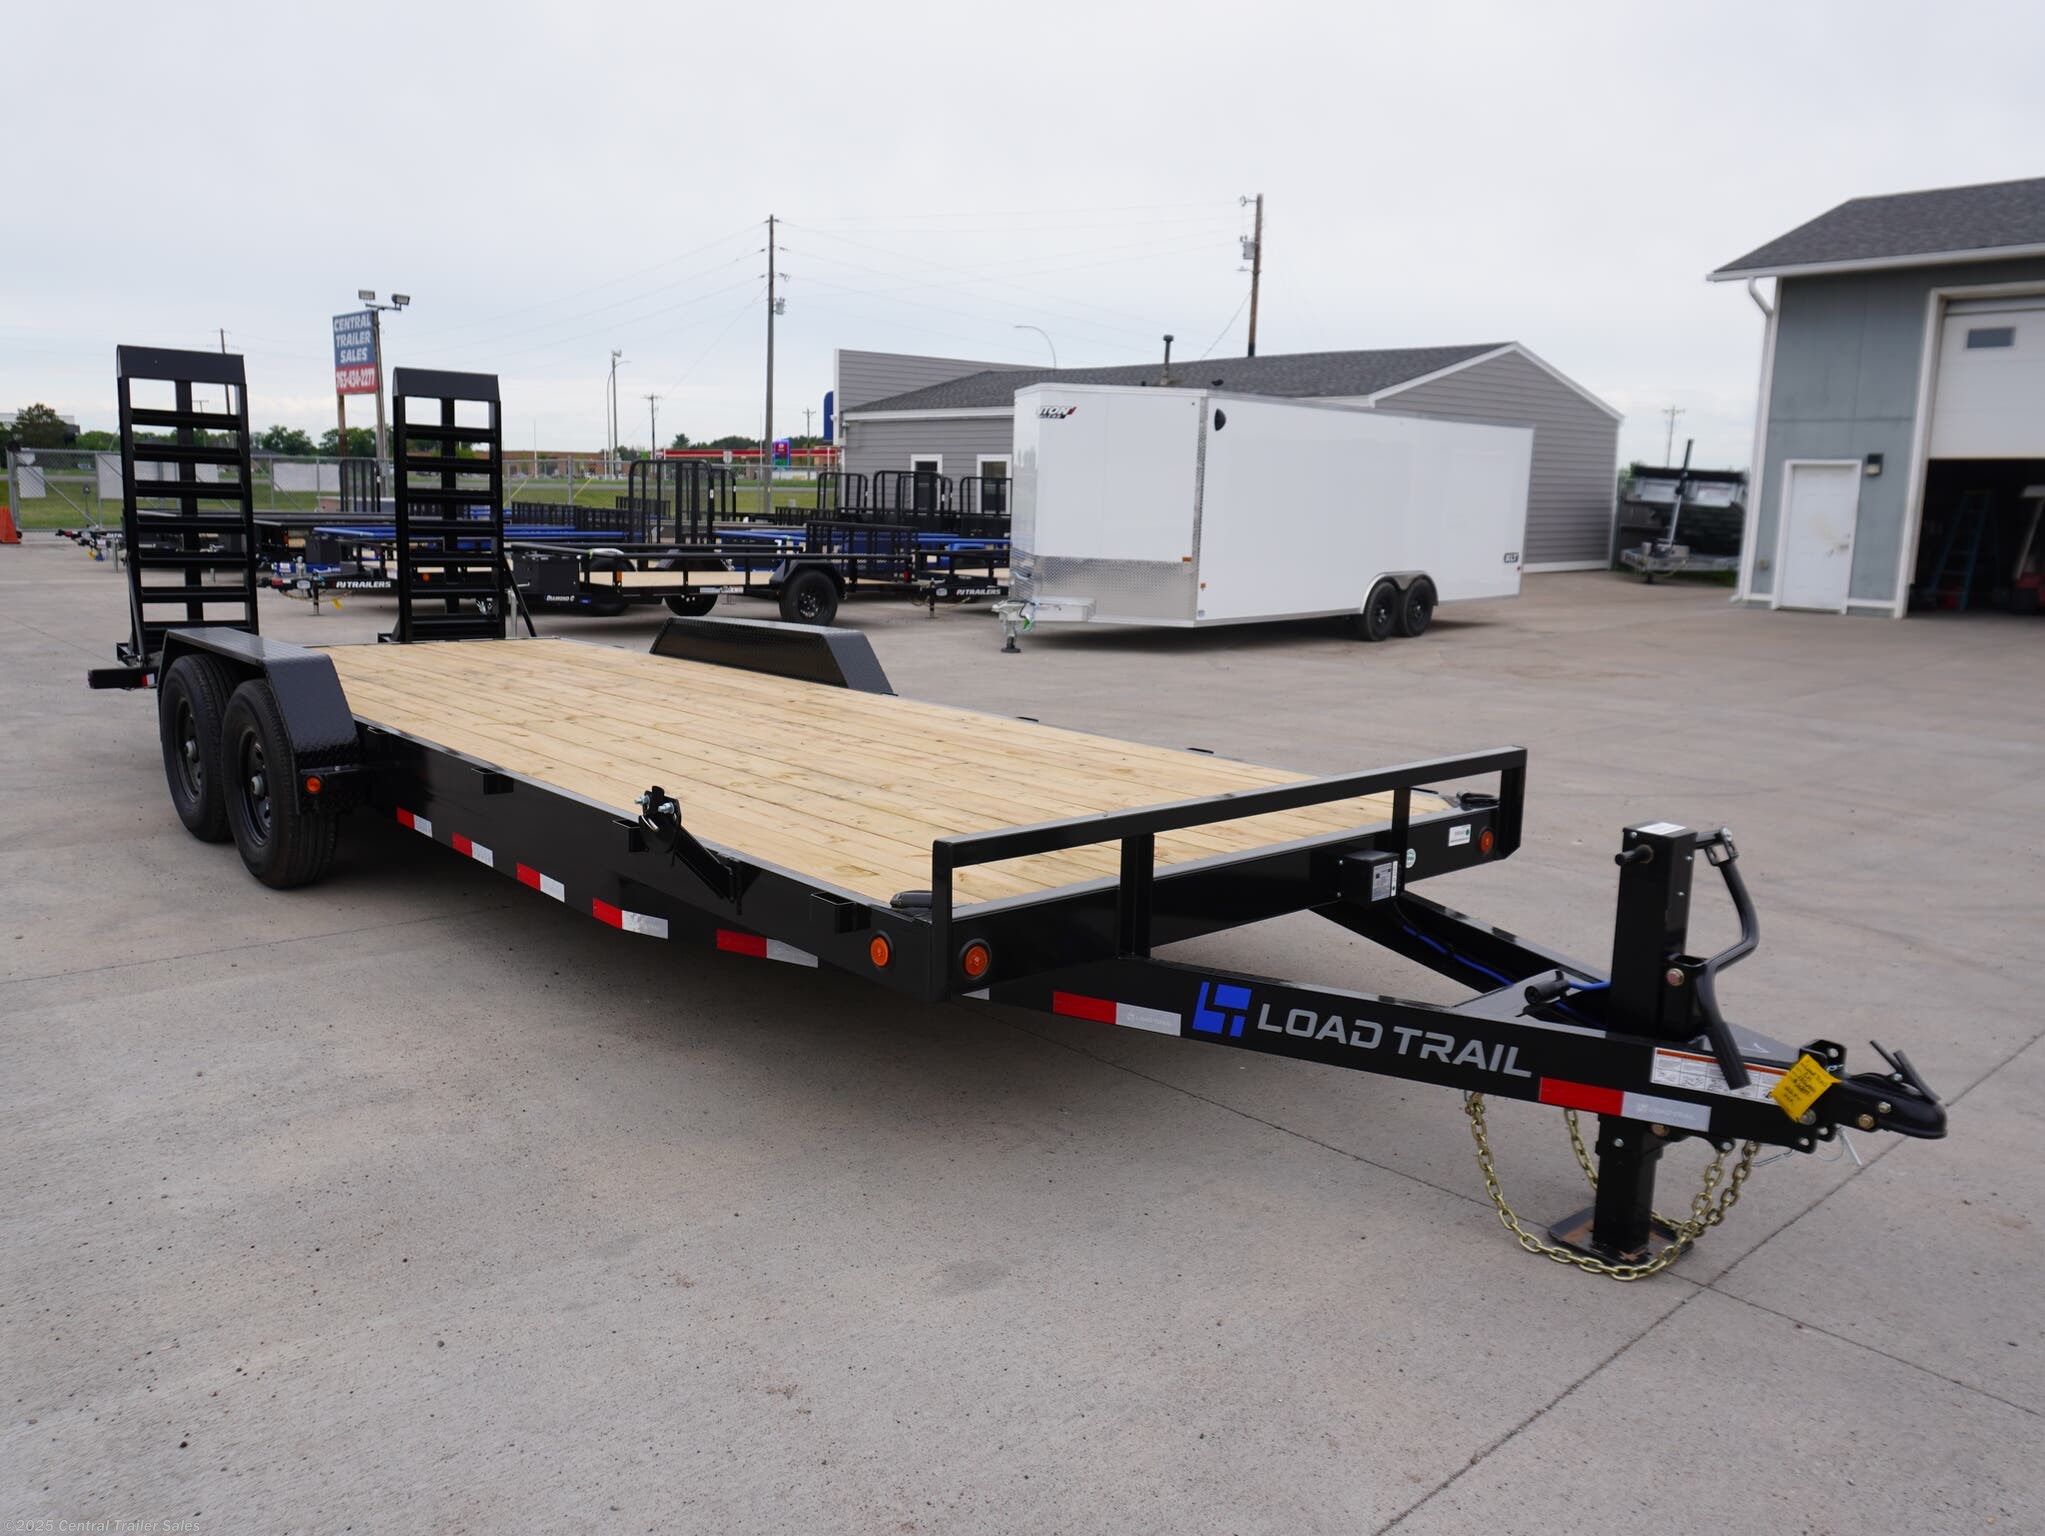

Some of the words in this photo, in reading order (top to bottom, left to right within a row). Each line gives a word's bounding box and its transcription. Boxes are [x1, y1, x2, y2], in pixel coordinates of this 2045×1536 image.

[335, 314, 370, 331] CENTRAL
[335, 331, 370, 348] TRAILER
[340, 347, 367, 363] SALES
[347, 580, 391, 588] TRAILERS
[1257, 1003, 1383, 1049] LOAD
[1393, 1026, 1532, 1078] TRAIL
